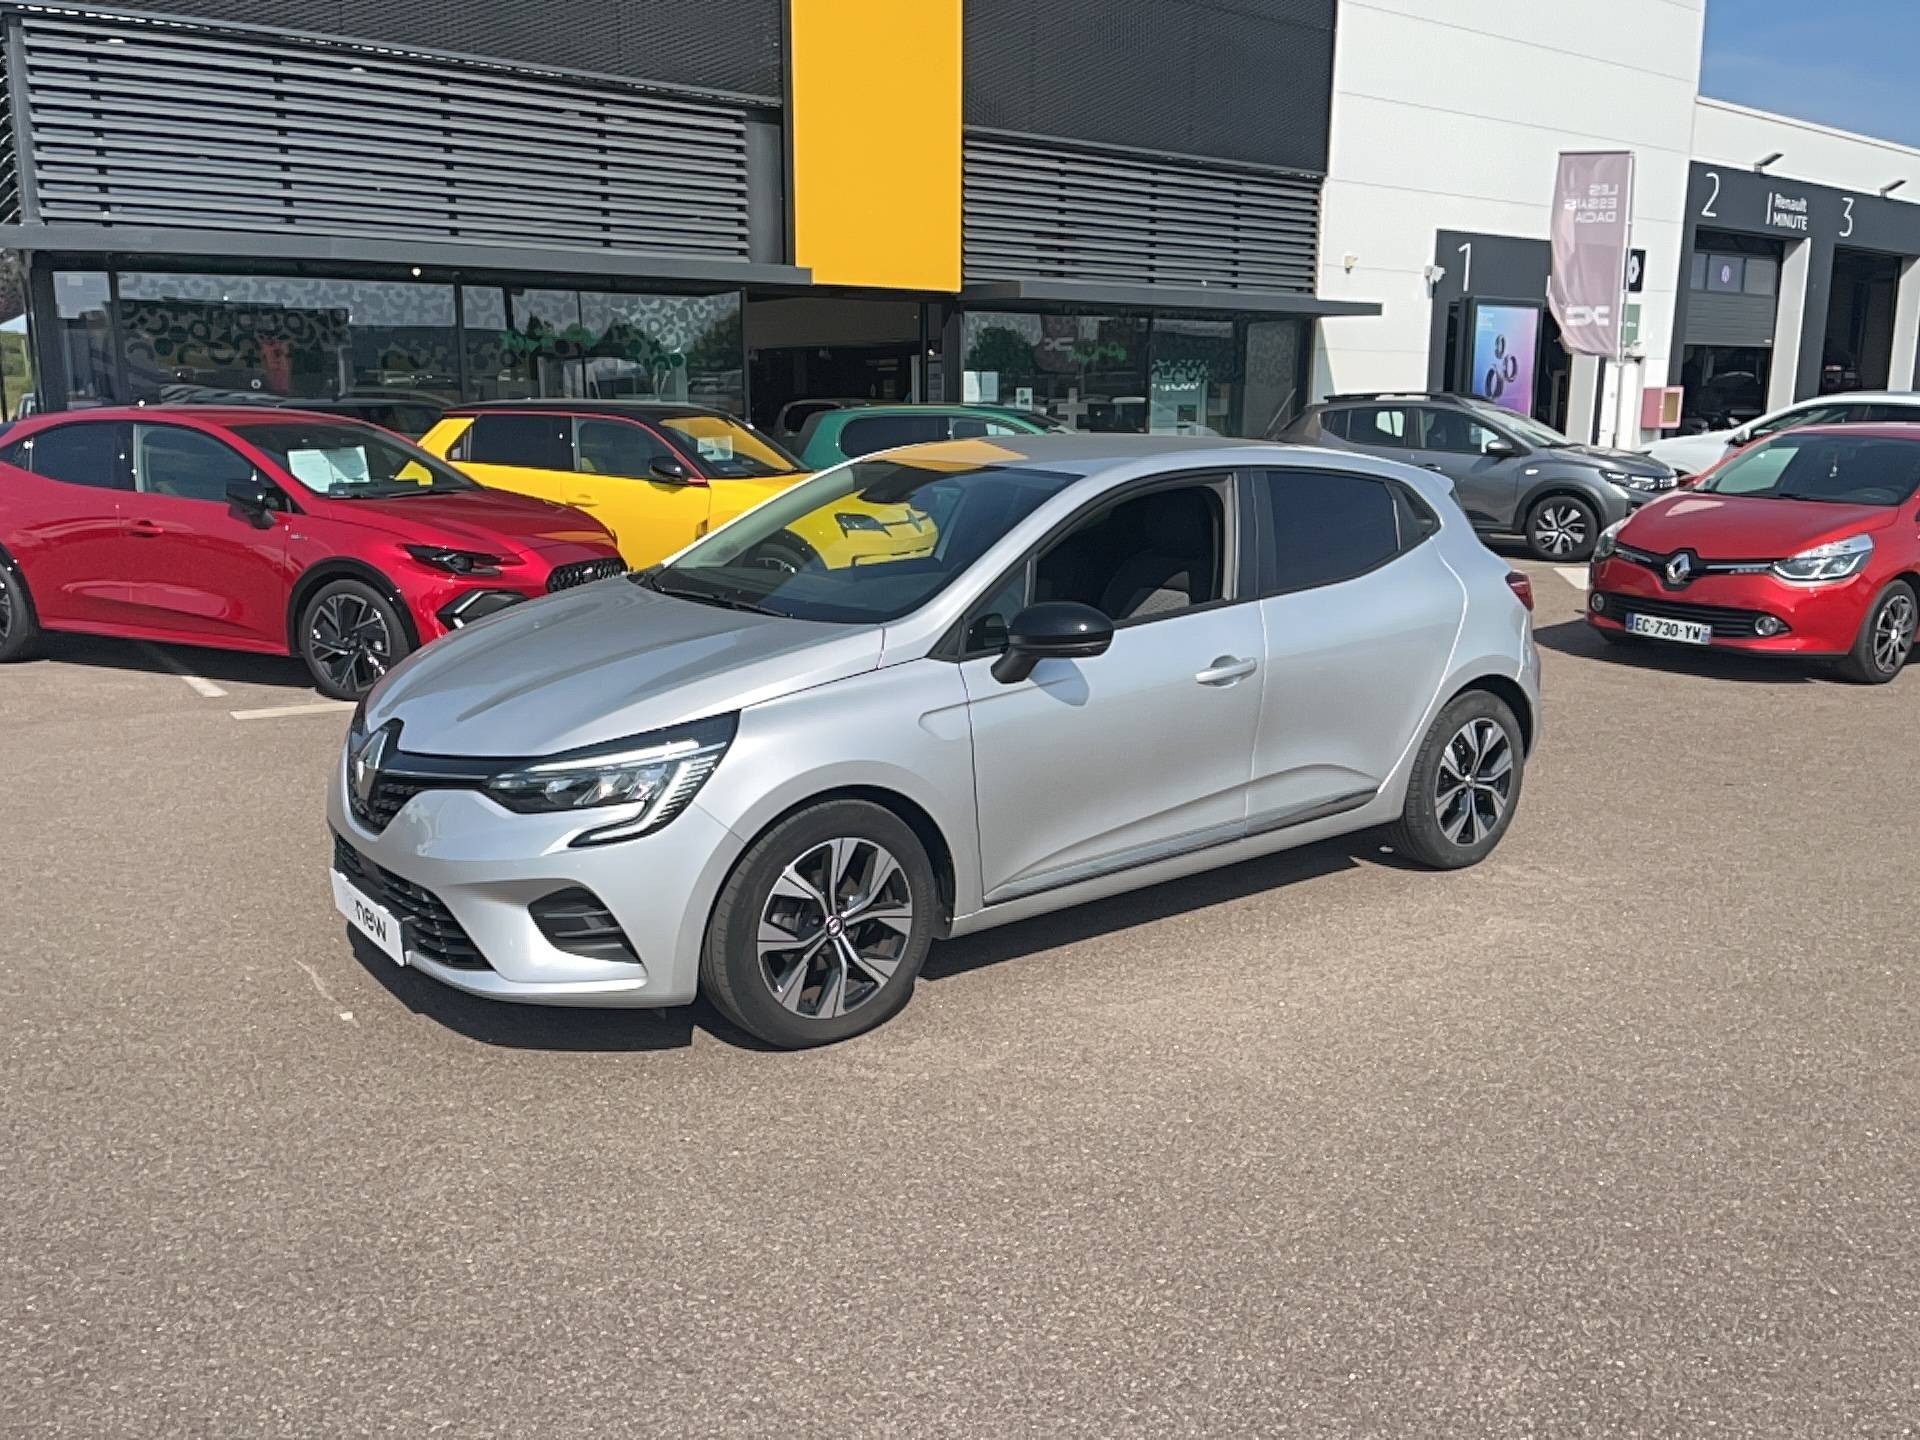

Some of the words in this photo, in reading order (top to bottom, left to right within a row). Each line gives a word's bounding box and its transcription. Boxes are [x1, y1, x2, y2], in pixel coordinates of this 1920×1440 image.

[1701, 172, 1719, 217] 2
[1775, 192, 1808, 213] Renault
[1772, 211, 1808, 231] MINUTE
[1838, 197, 1855, 237] 3
[1457, 243, 1471, 291] 1
[355, 899, 387, 943] new
